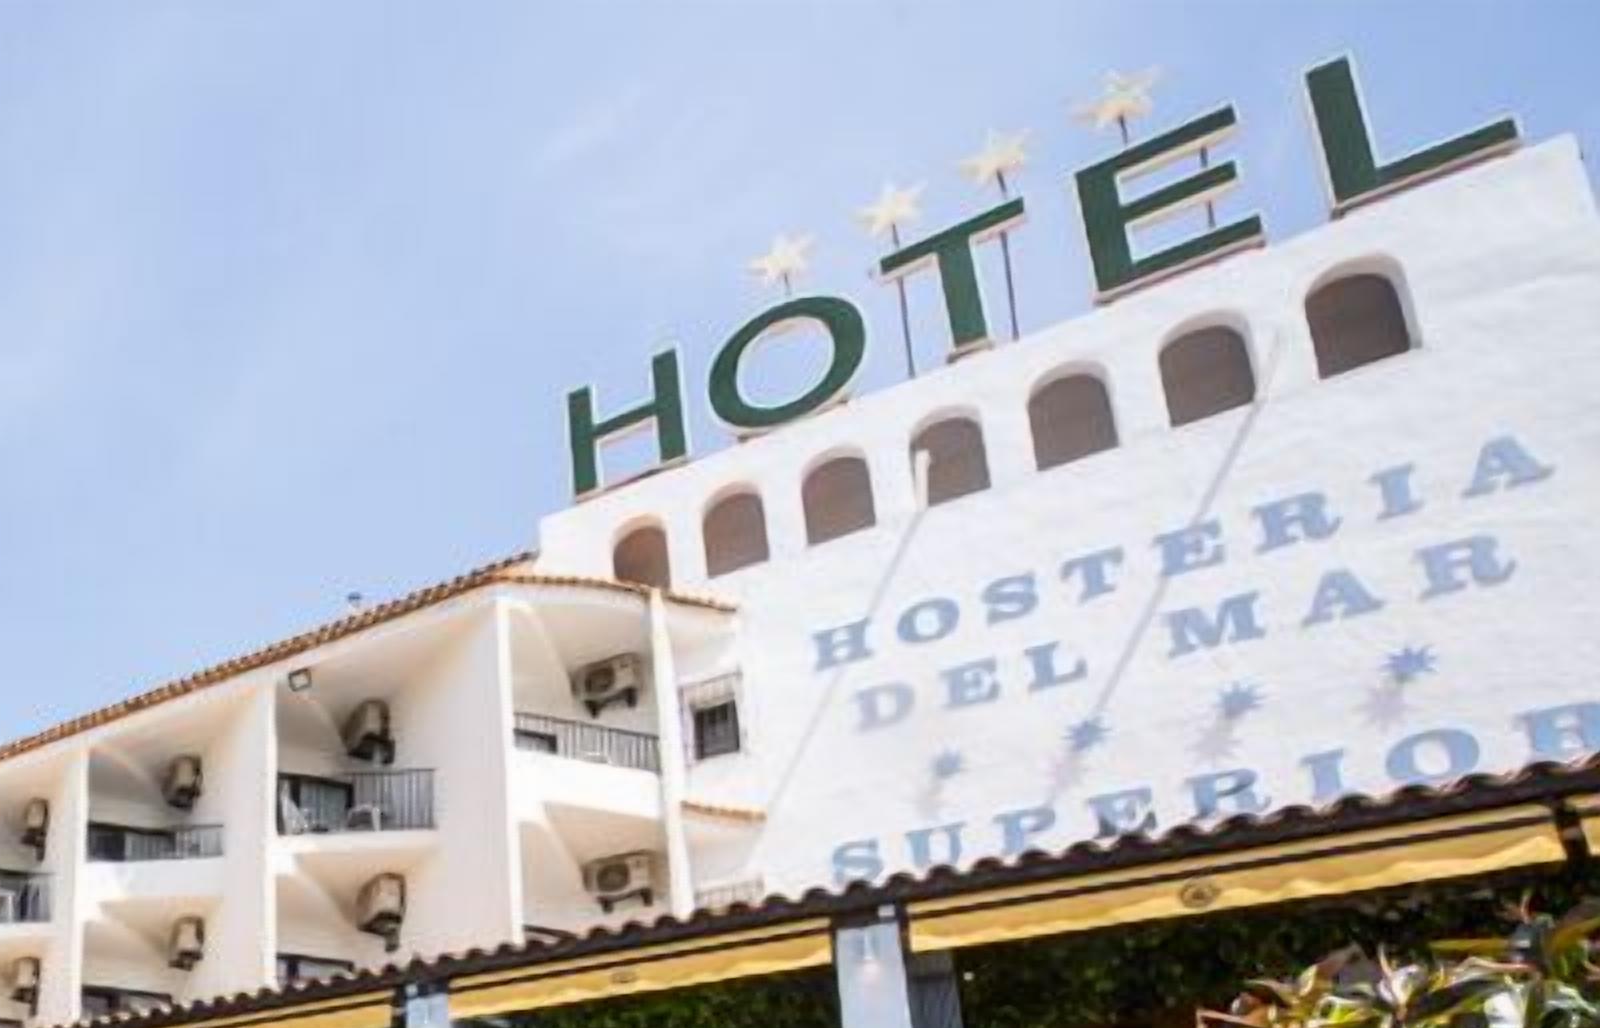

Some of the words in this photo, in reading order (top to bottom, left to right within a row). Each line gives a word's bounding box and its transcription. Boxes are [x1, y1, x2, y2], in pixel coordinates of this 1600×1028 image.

[567, 54, 1521, 498] HOTEL
[812, 433, 1556, 671] HOSTERIA
[854, 642, 1089, 732] DEL
[1162, 534, 1517, 660] MAR
